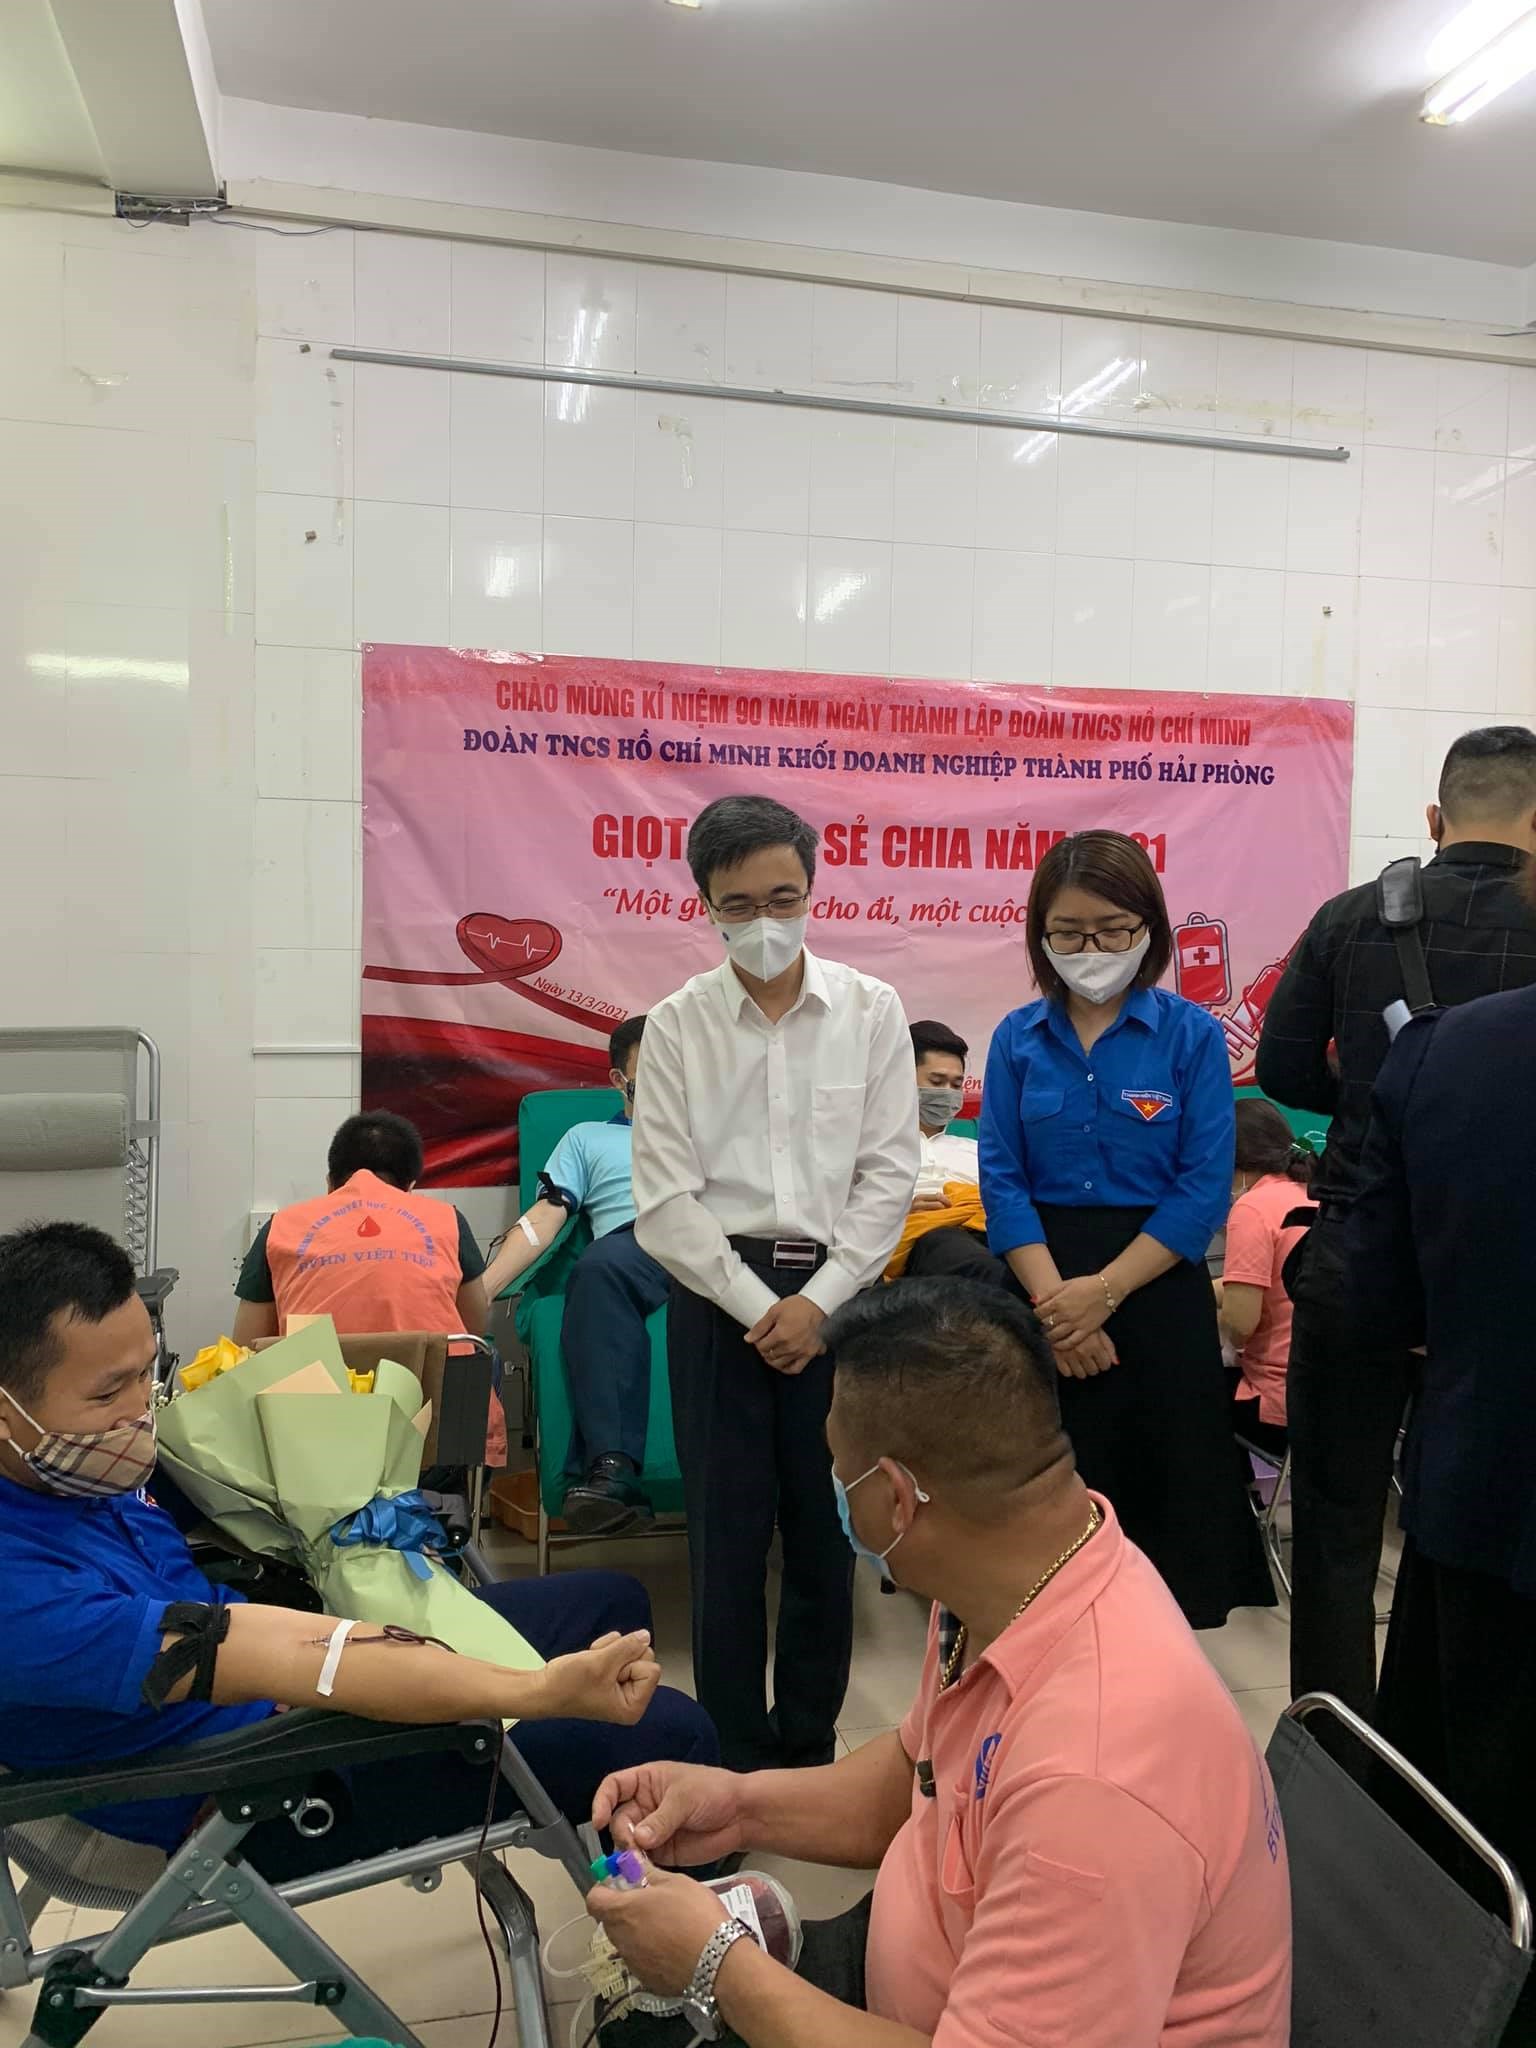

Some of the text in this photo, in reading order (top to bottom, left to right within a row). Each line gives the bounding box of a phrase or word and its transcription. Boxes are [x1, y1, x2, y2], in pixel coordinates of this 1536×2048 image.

[496, 677, 1251, 746] CHÀO MỪNG KỈ NIỆM 90 NĂM NGÀY THÀNH LẬP ĐOÀN TNCS HỒ CHÍ MINH
[463, 725, 1275, 785] ĐOÀN TNCS HỒ CHÍ MINH KHỐI DOANH NGHIỆP THÀNH PHỐ HẢI PHÒNG
[592, 813, 688, 868] GIỌT
[823, 814, 869, 866] SẺ
[881, 825, 973, 869] CHIA
[812, 896, 859, 919] cho
[867, 895, 900, 925] đi,
[909, 899, 963, 928] một
[968, 898, 1028, 928] cuộc
[533, 976, 629, 1021] Ngày 13/3/2021
